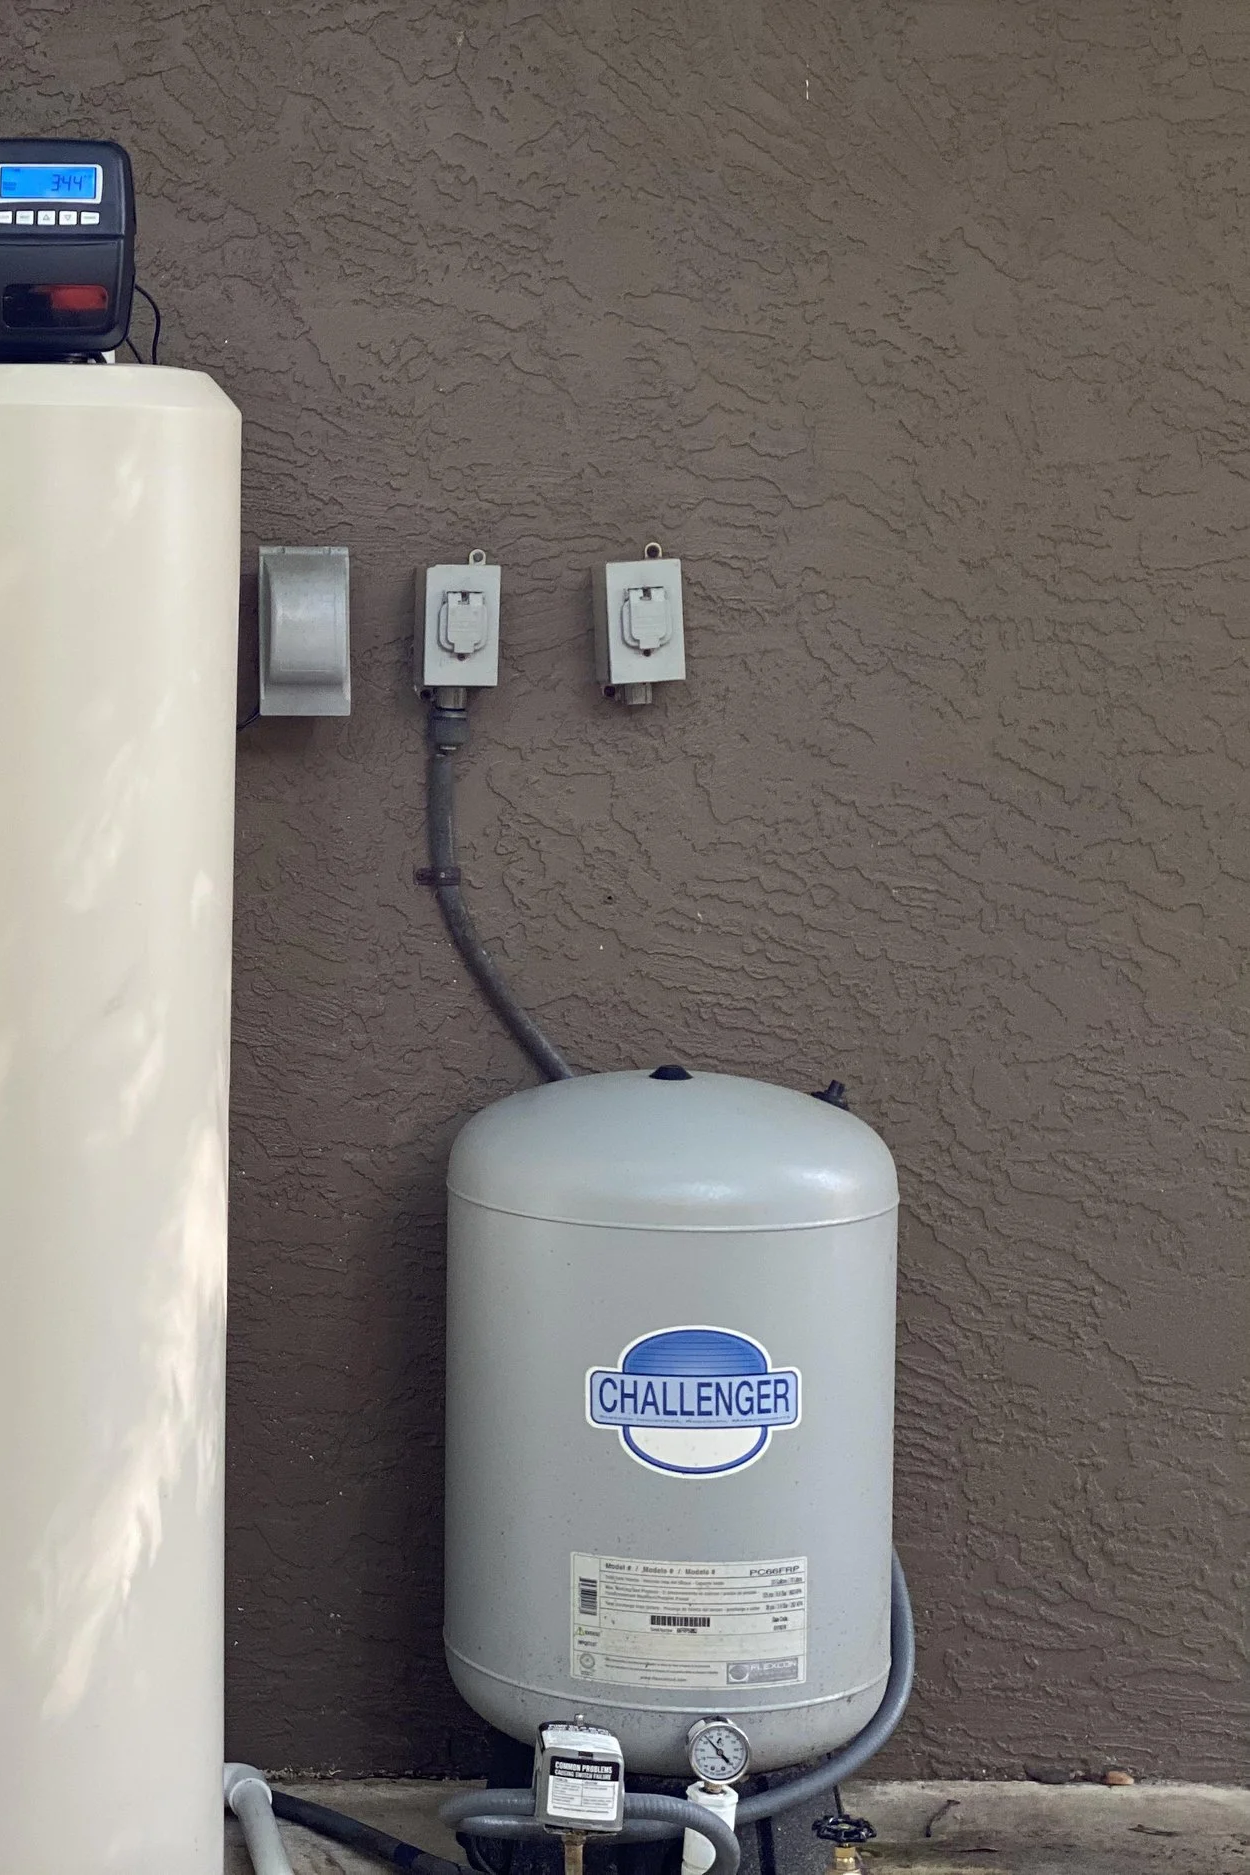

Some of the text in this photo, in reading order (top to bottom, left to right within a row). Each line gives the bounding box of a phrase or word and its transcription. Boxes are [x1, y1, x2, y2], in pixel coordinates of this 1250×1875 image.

[599, 1377, 790, 1417] CHALLENGER
[555, 1761, 612, 1773] COMMON PROBLEMS
